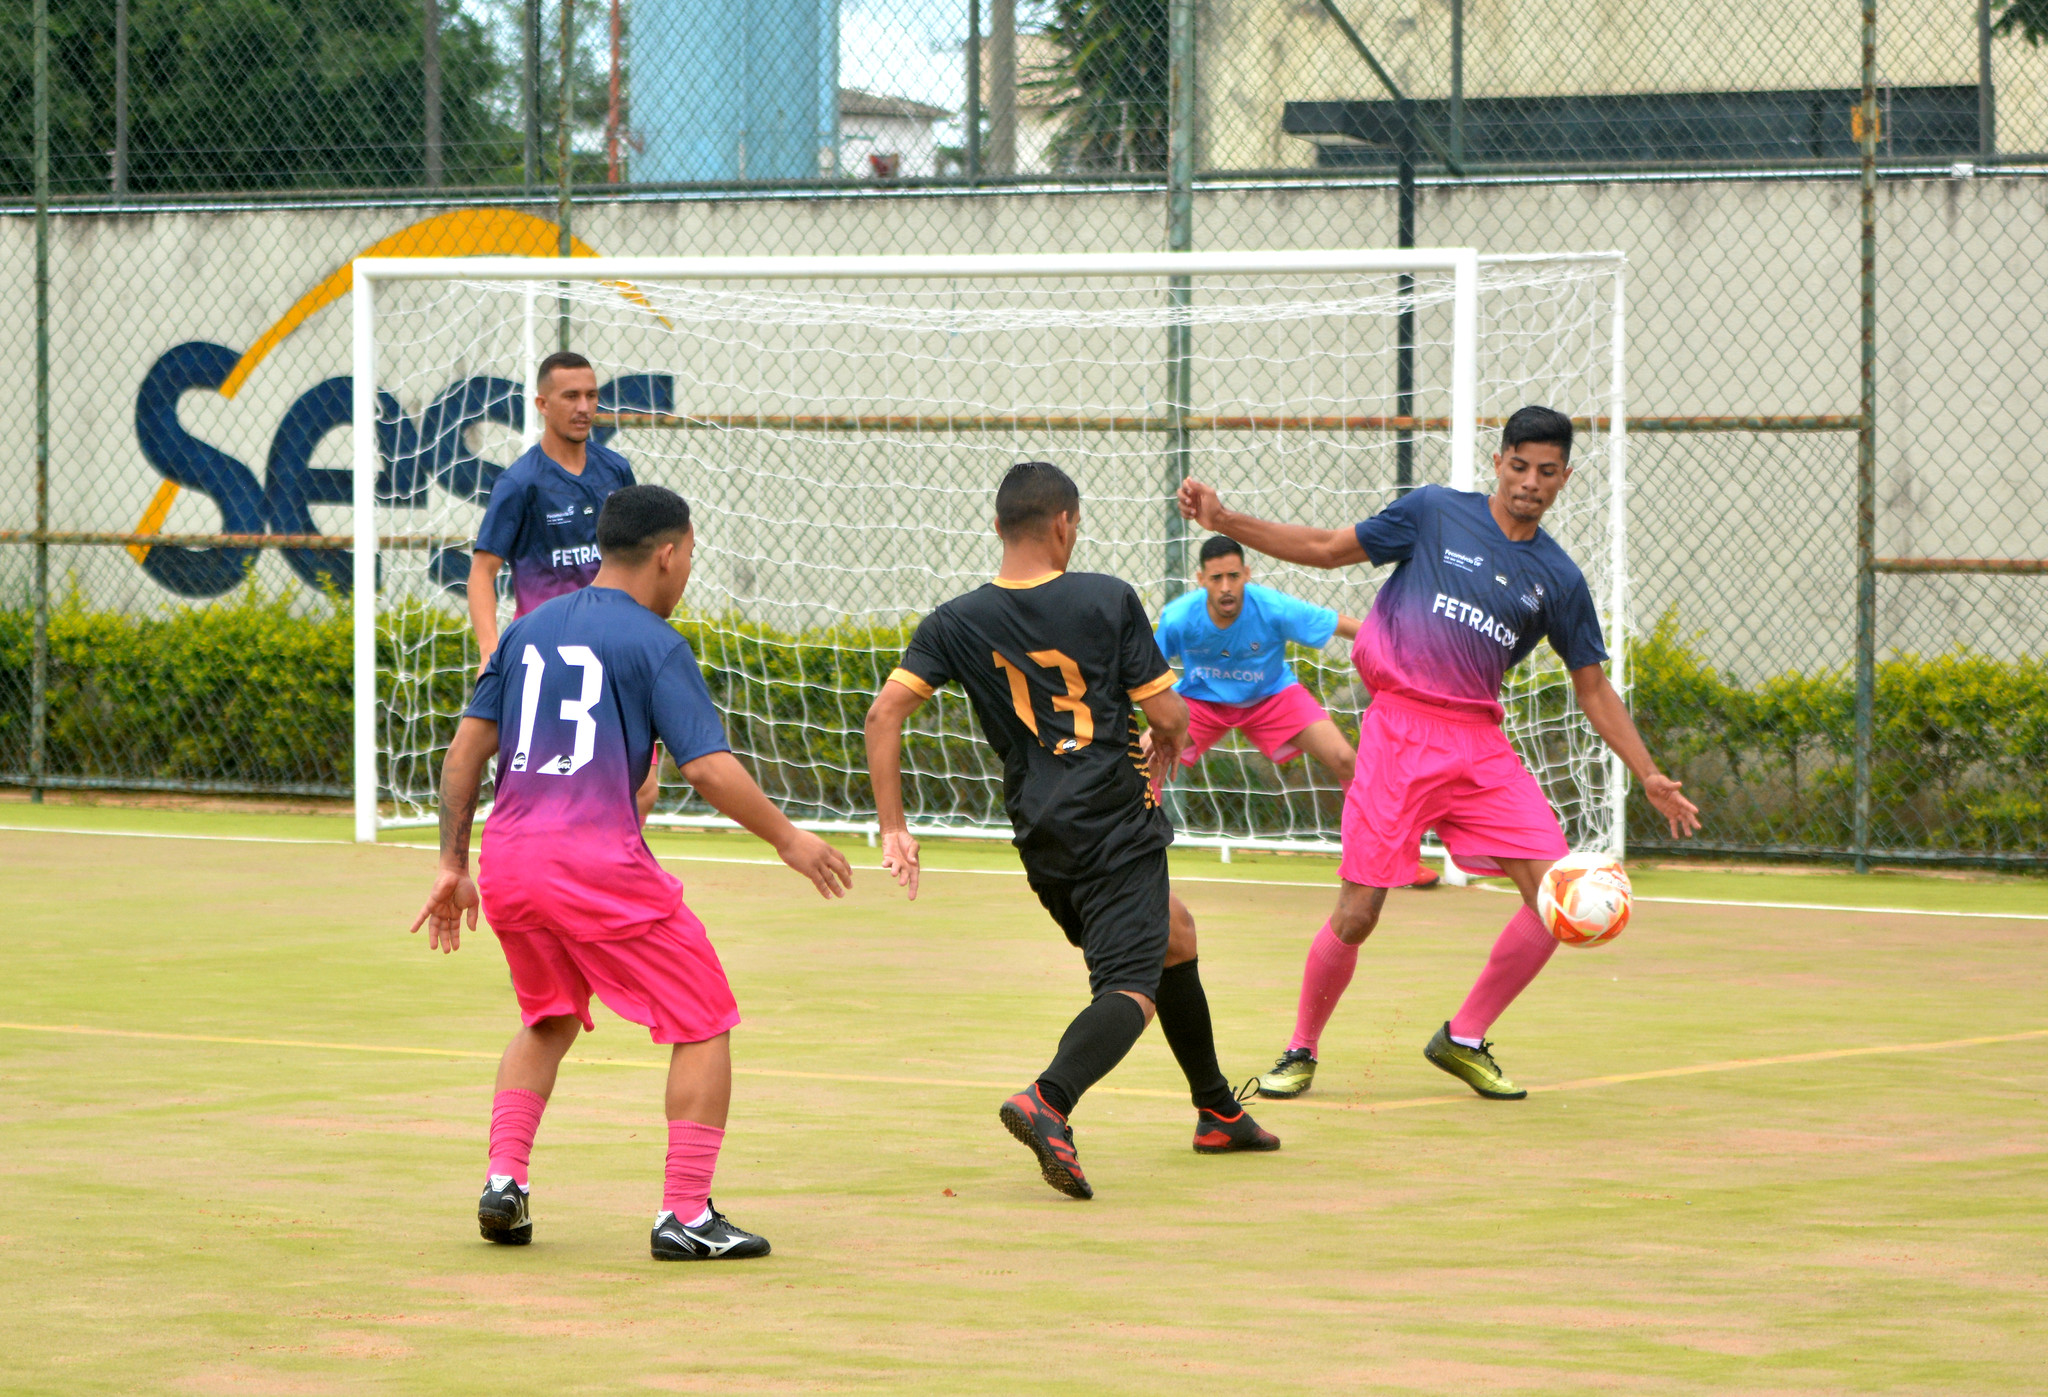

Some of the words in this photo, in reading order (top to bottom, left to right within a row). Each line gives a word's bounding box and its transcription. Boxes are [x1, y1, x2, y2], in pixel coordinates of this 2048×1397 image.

[136, 342, 674, 599] Ses
[510, 644, 603, 776] 13
[992, 649, 1094, 756] 13
